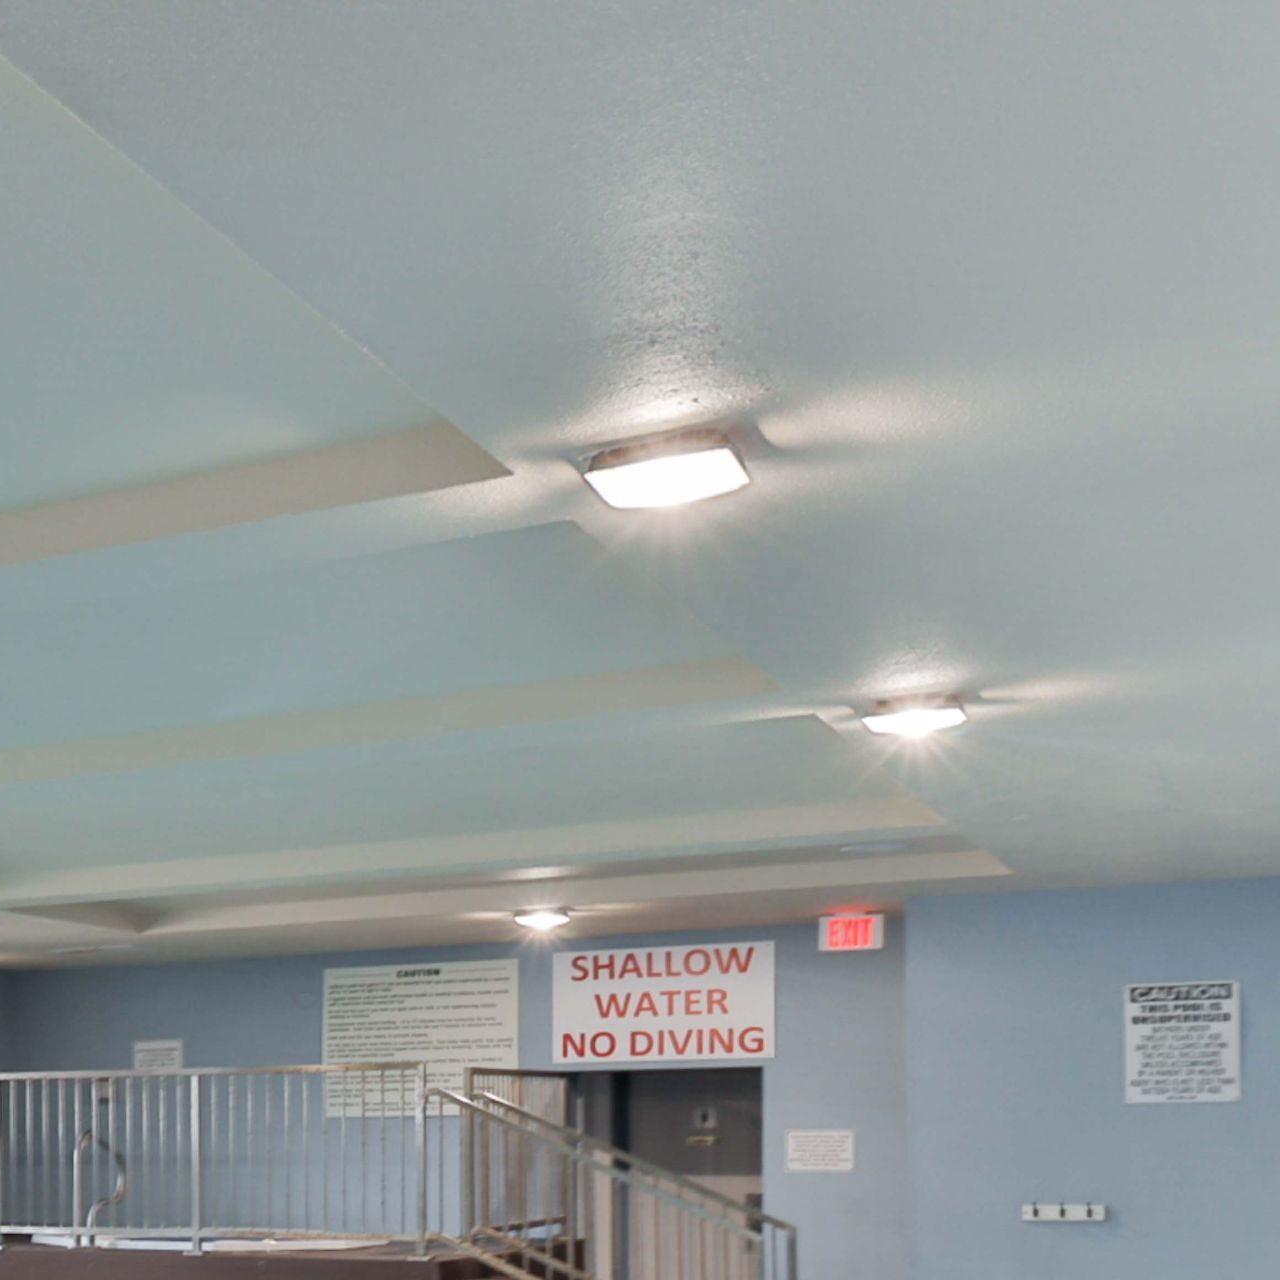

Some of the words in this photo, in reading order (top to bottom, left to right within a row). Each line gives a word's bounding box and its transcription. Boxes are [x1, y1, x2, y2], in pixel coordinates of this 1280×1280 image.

[828, 918, 874, 948] EXIT
[396, 968, 440, 979] CAUTION
[570, 947, 754, 982] SHALLOW
[594, 989, 729, 1018] WATER
[1133, 985, 1229, 1001] CAUTION
[562, 1031, 616, 1058] NO
[629, 1026, 764, 1056] DIVING
